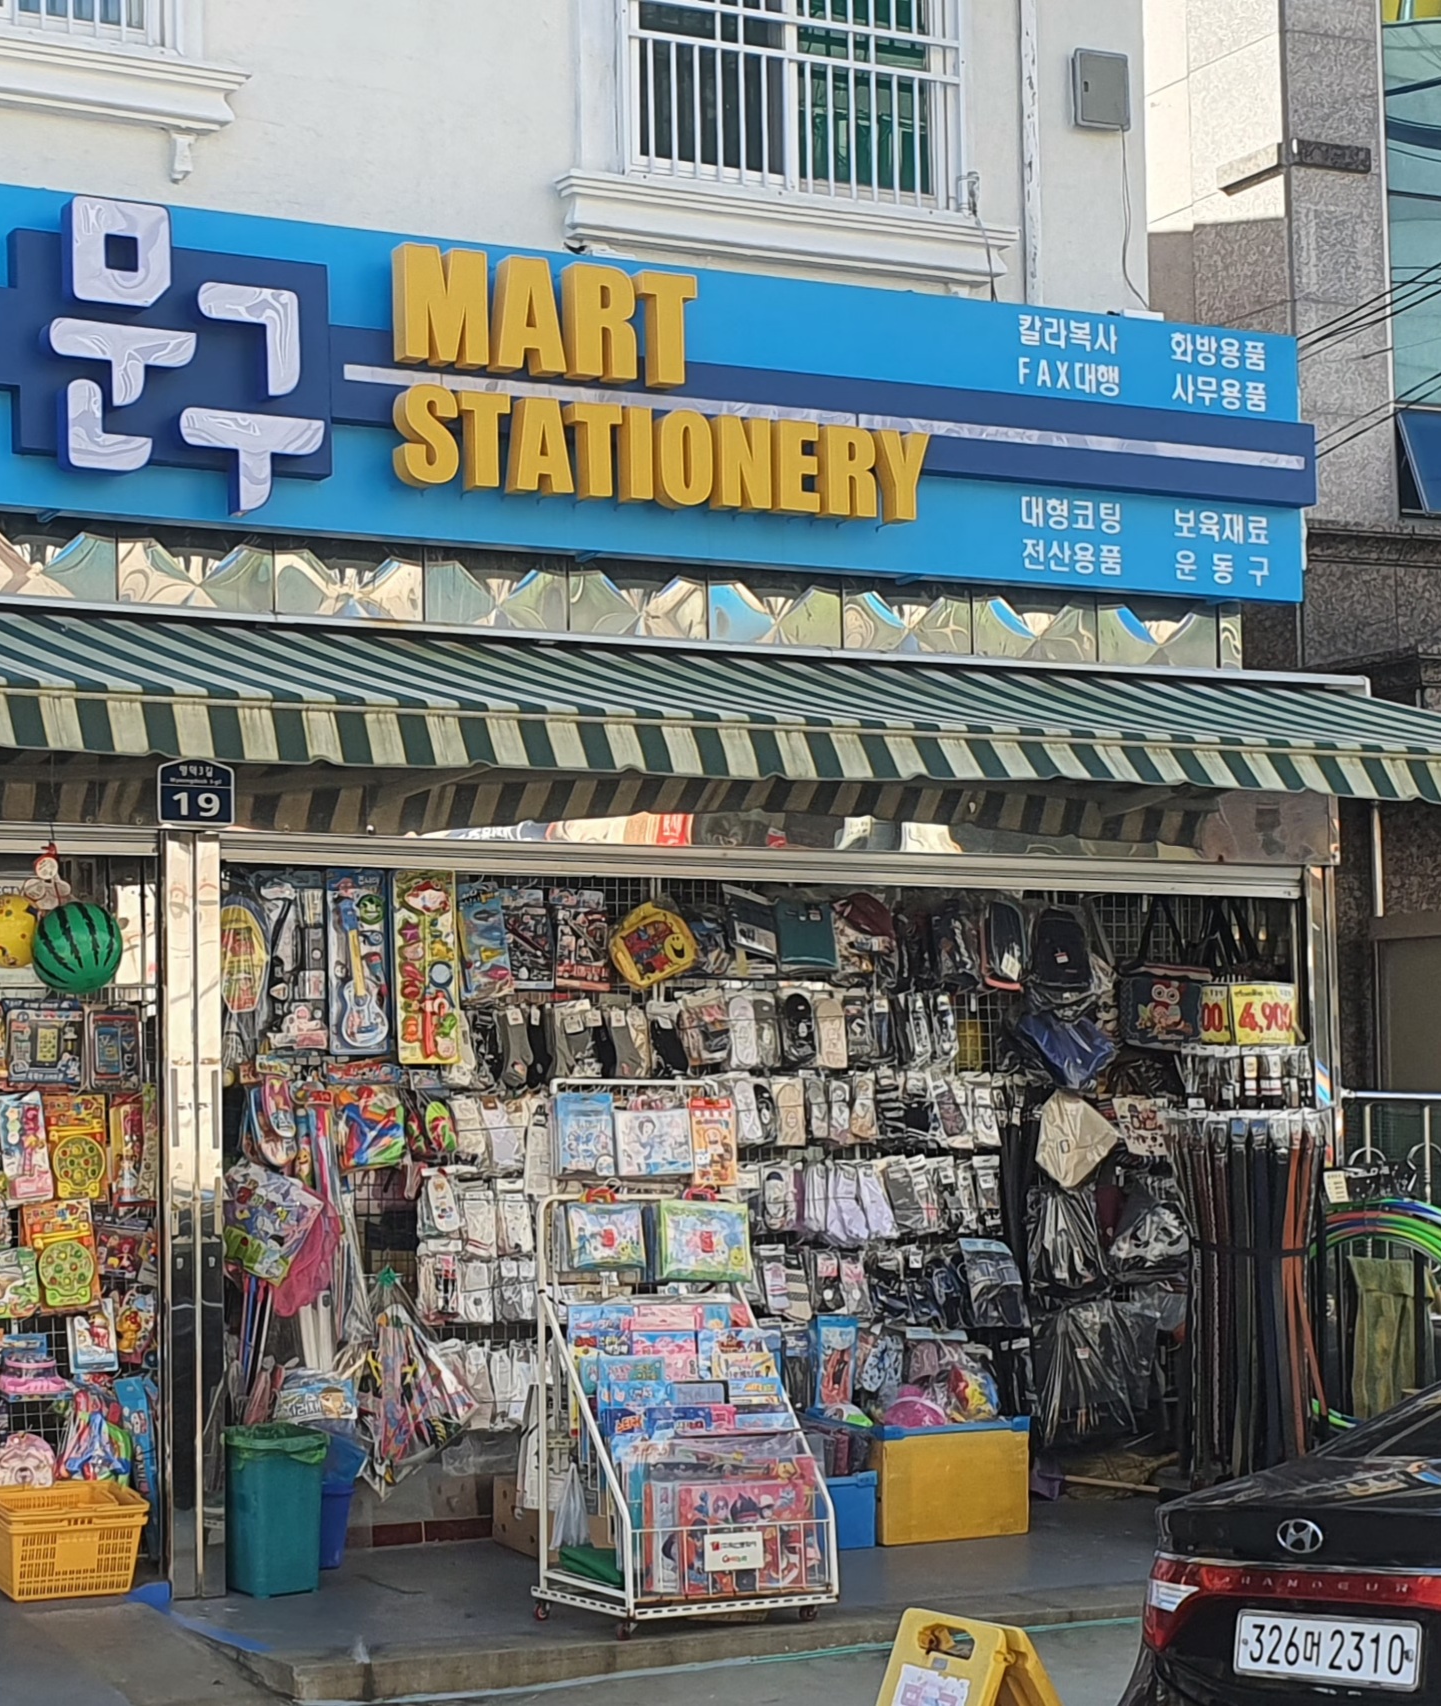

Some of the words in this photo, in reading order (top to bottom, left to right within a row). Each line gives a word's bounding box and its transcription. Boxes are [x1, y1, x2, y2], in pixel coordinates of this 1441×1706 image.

[392, 242, 698, 388] MART
[1018, 314, 1118, 354] 칼라복사
[42, 195, 326, 515] 문구
[1170, 332, 1266, 371] 화방용품
[1172, 373, 1267, 412] 사무용품
[393, 383, 930, 524] STATIONERY
[1021, 496, 1121, 534] 대형코팅
[1174, 508, 1270, 545] 보육재료
[1022, 538, 1122, 576] 전산용품
[172, 792, 221, 817] 19
